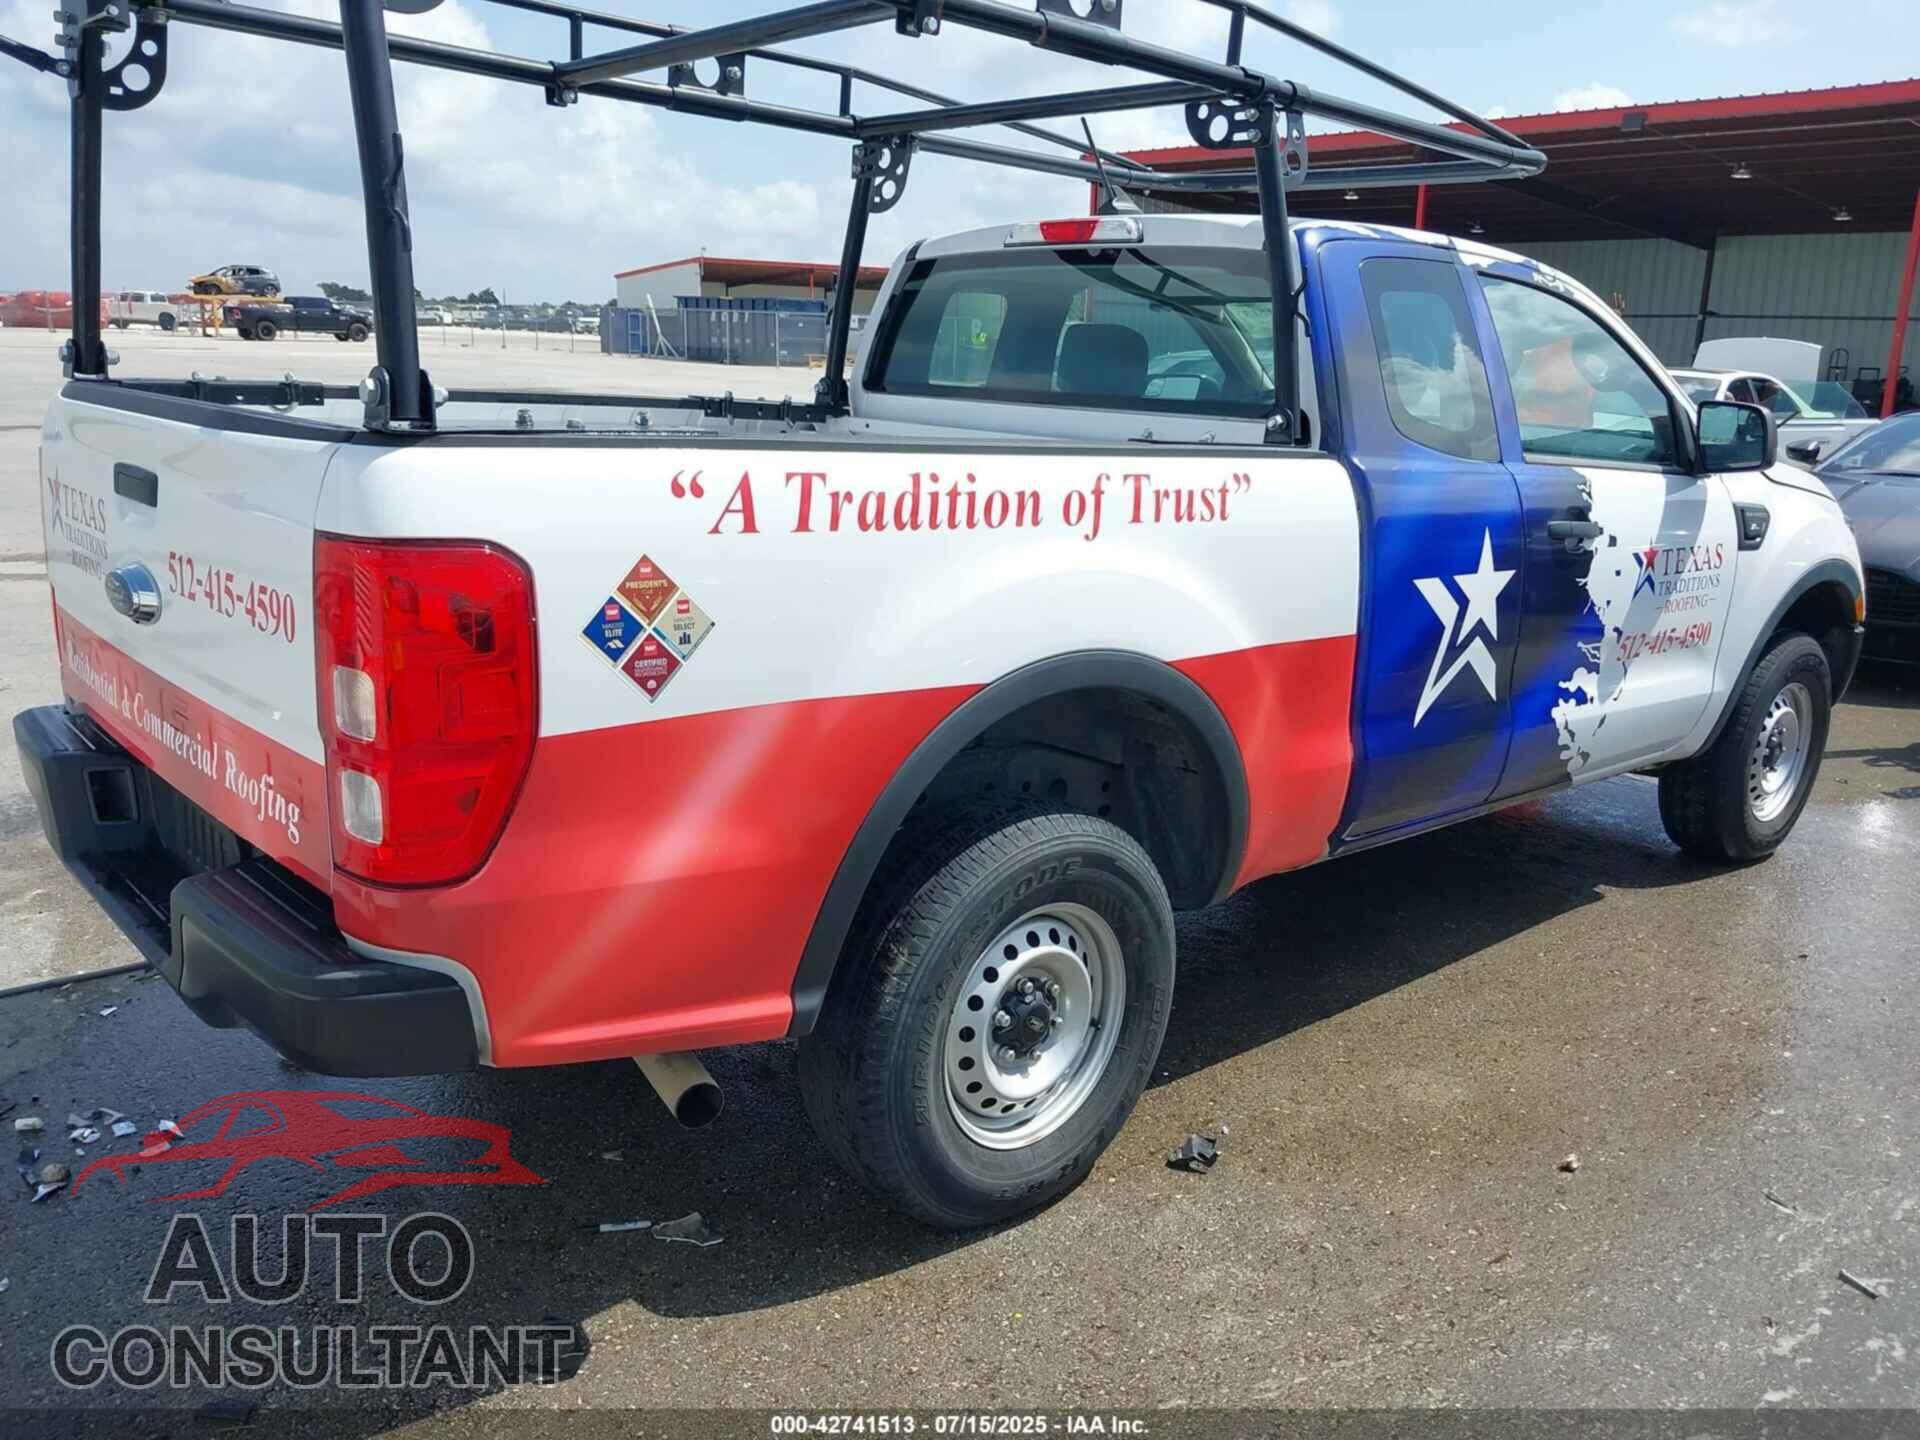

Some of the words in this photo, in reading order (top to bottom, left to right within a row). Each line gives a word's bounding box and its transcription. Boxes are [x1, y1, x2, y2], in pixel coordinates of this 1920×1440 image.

[62, 482, 106, 534] TEXAS
[785, 471, 1044, 534] Tradition
[1062, 473, 1111, 542] of
[64, 521, 108, 561] TRADITIONS
[1661, 543, 1724, 576] TEXAS
[167, 550, 296, 644] 512-415-4590
[1658, 573, 1721, 597] TRADITIONS
[1663, 594, 1709, 614] ROOFING
[1616, 622, 1712, 661] 512-415-4590
[133, 692, 218, 780] Commercial
[224, 749, 300, 845] Roofing
